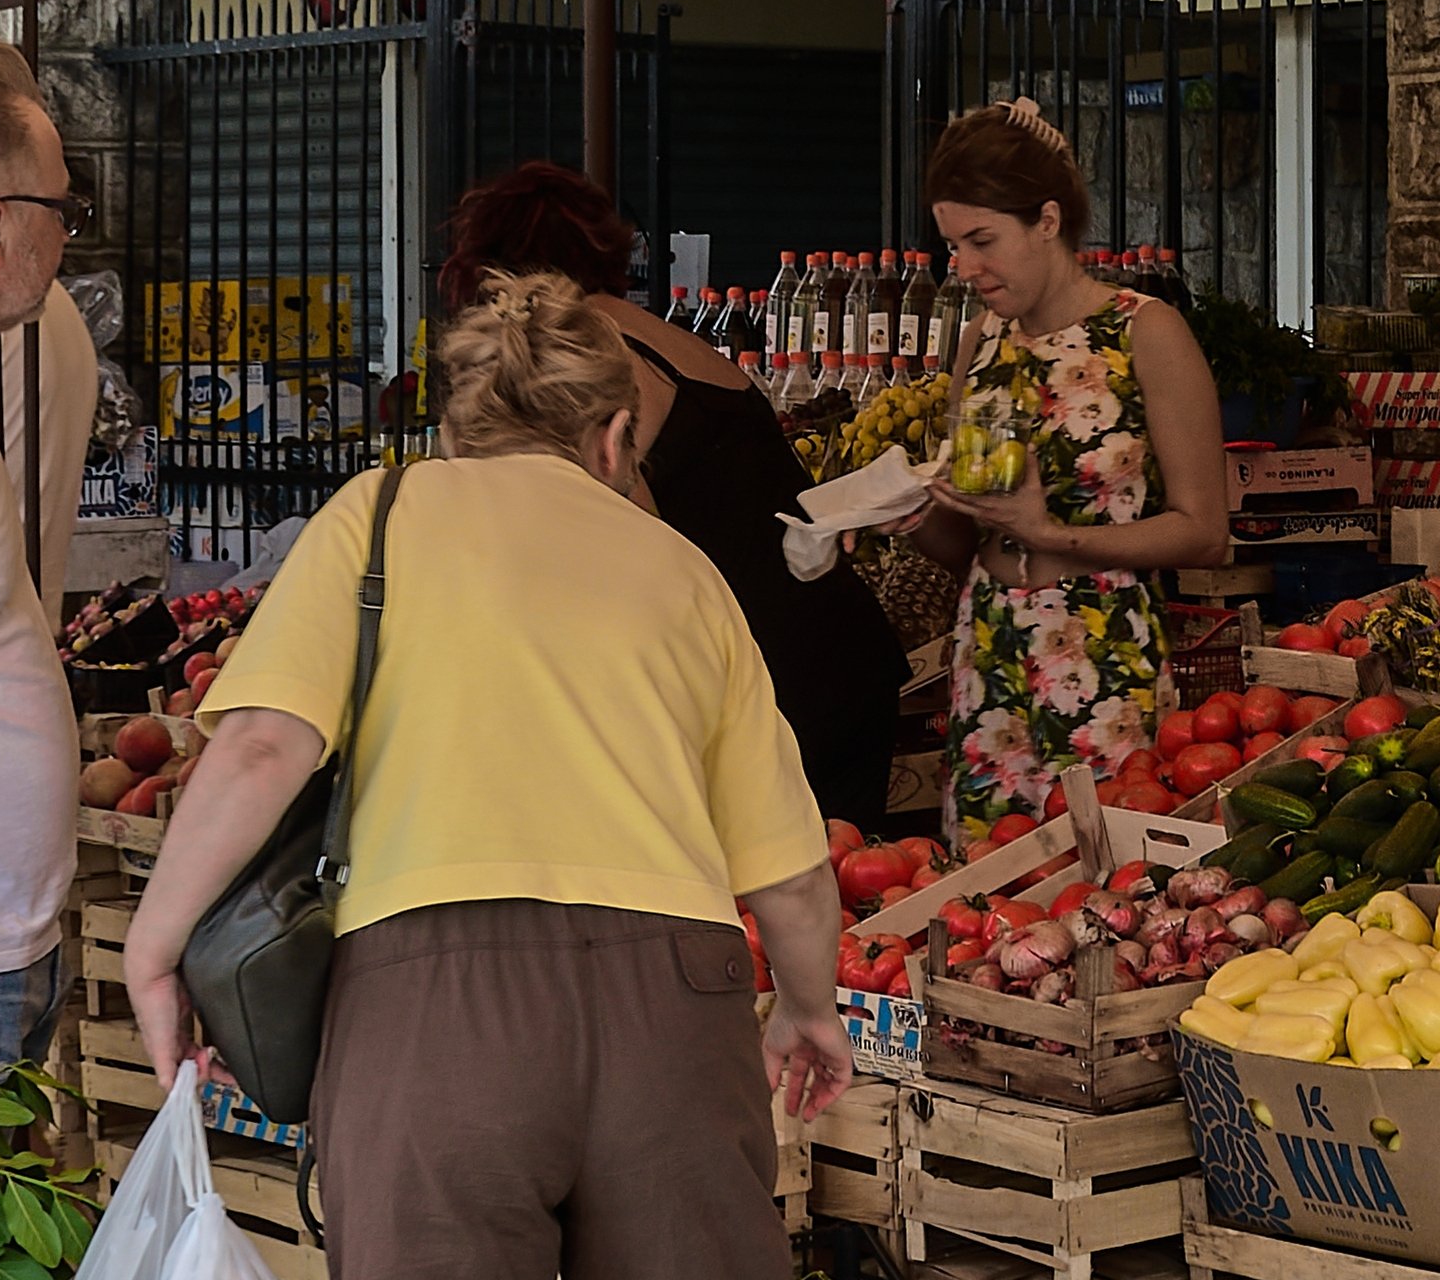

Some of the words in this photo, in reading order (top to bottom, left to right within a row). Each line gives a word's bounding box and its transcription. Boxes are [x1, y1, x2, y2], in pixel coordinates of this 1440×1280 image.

[1395, 387, 1421, 401] Super
[1279, 467, 1335, 480] FLAMINGO
[1275, 1132, 1408, 1217] KIKA
[1303, 1201, 1356, 1221] PREMIUM
[1359, 1209, 1414, 1232] BANANAS
